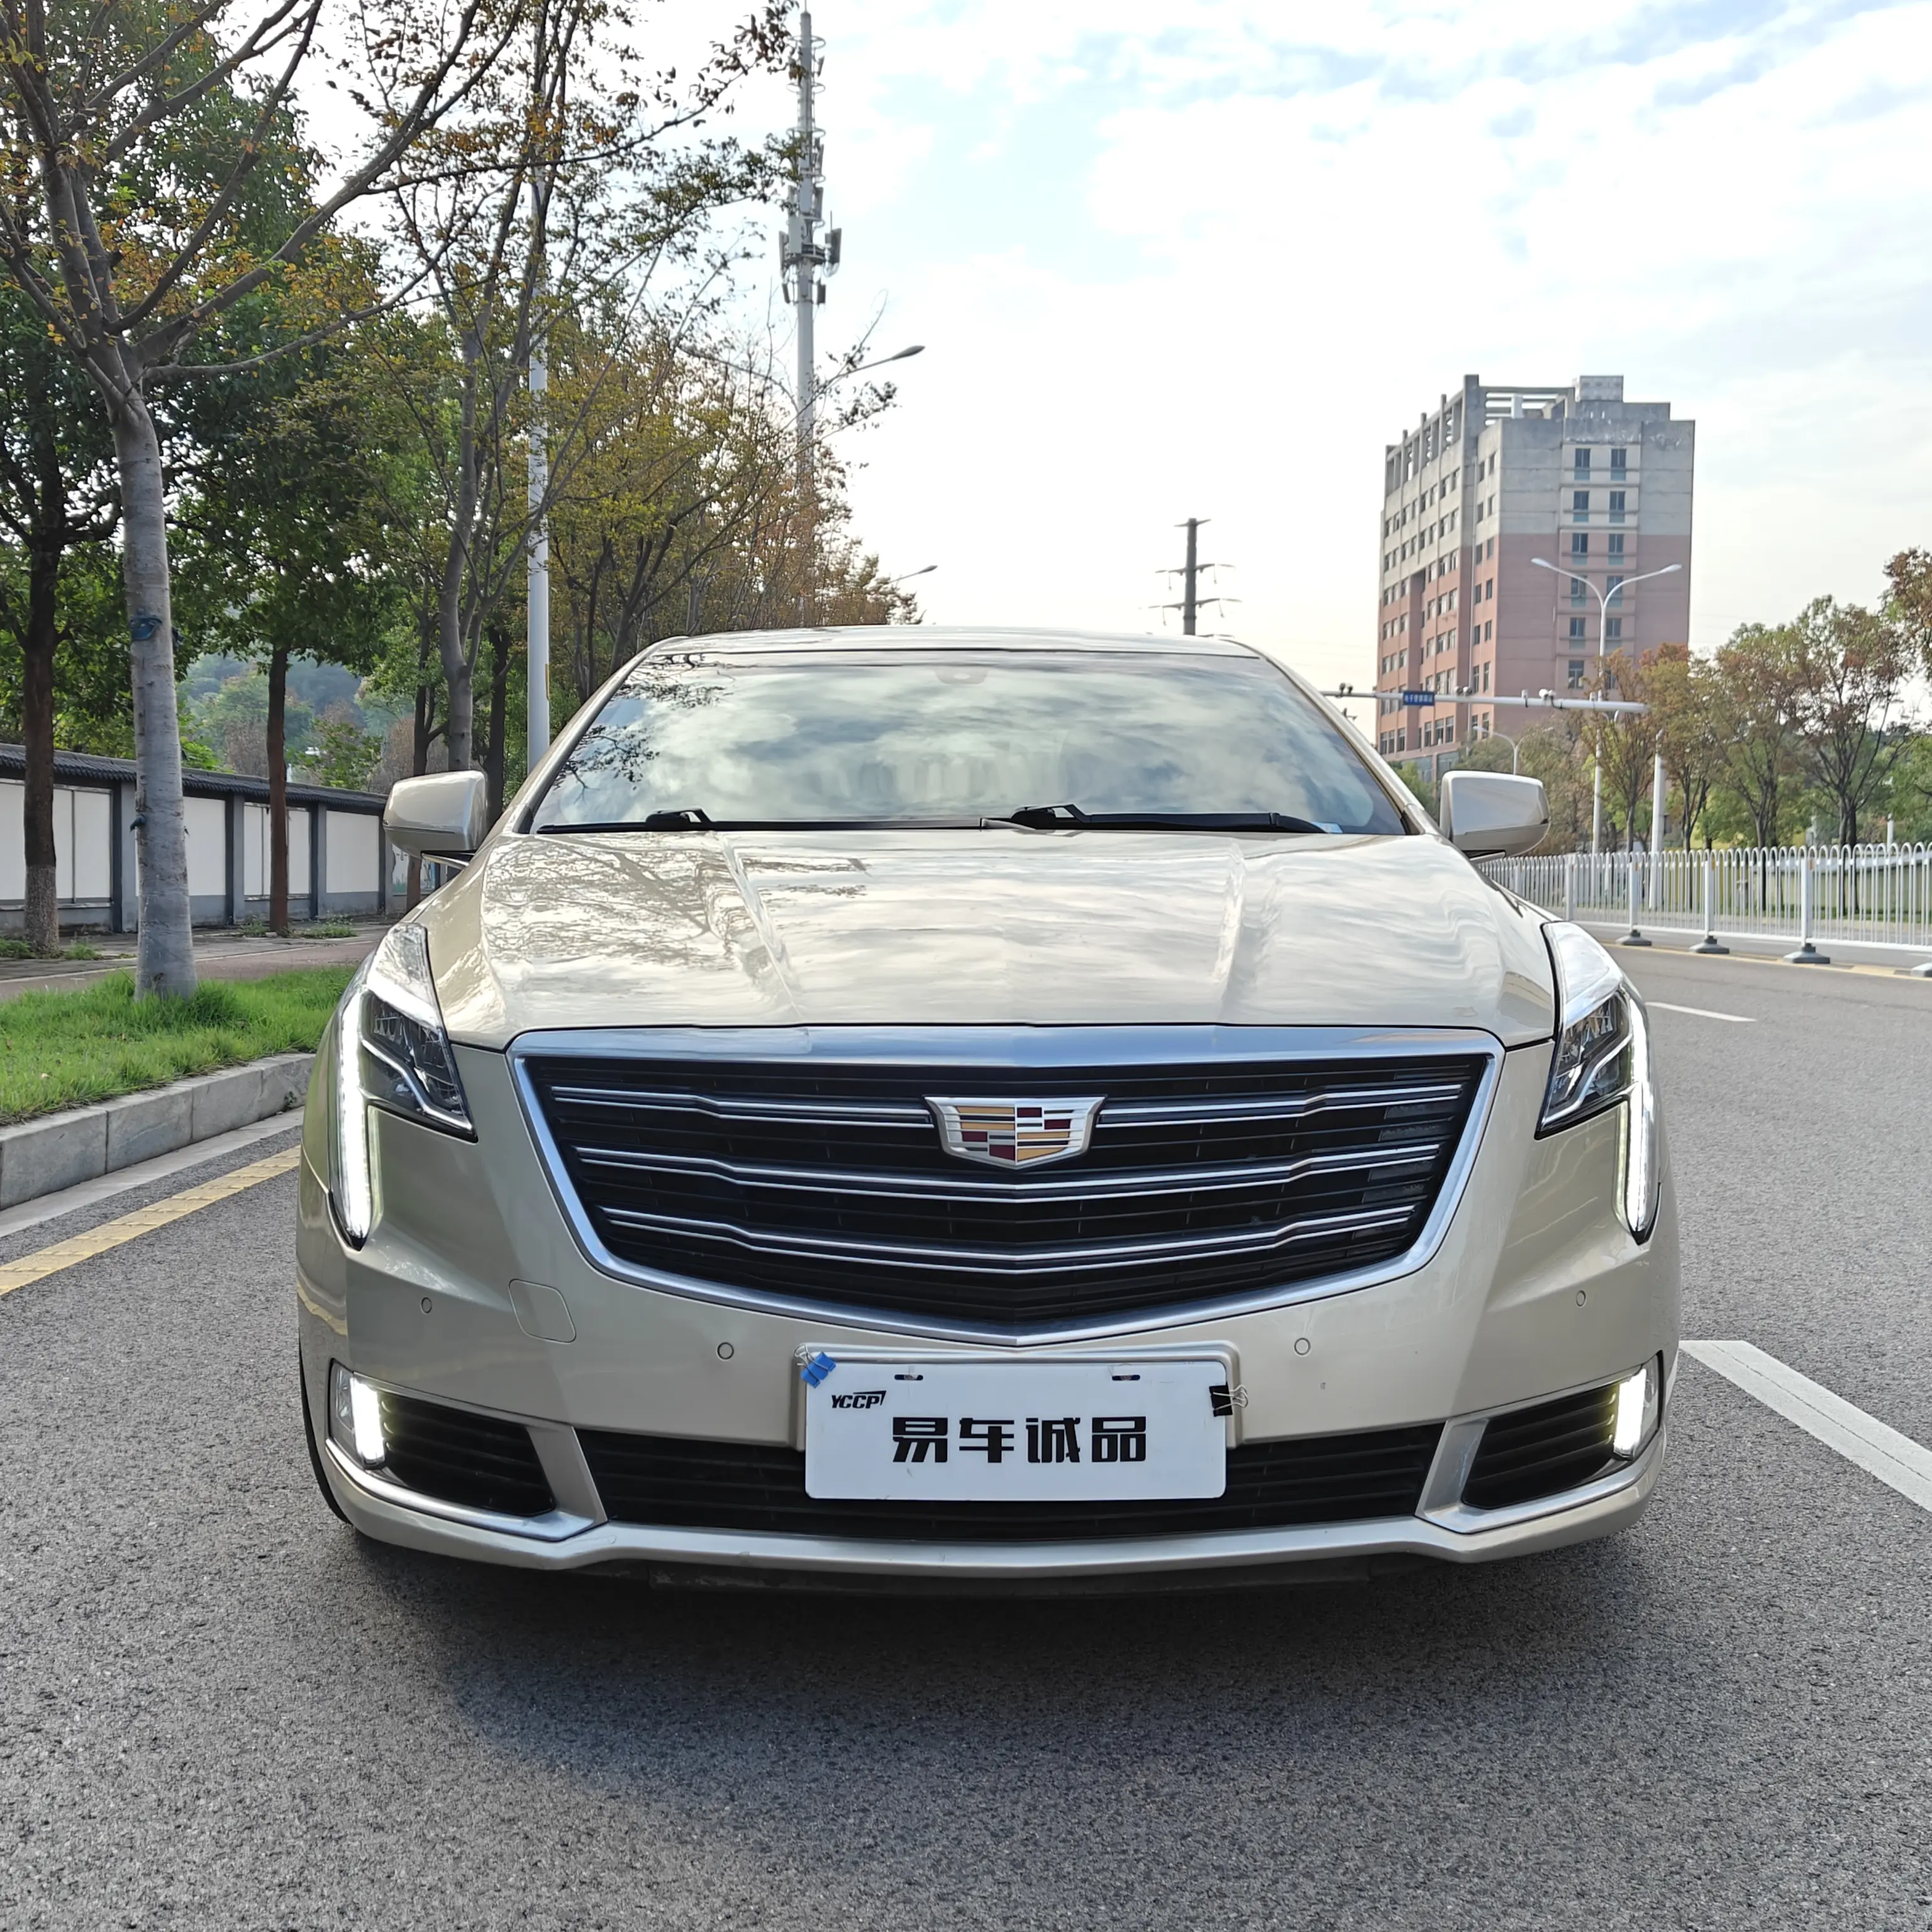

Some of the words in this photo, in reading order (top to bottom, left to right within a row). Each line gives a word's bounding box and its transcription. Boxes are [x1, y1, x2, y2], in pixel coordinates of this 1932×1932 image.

[831, 1394, 880, 1409] YCCP
[892, 1416, 1146, 1463] 易车诚品
